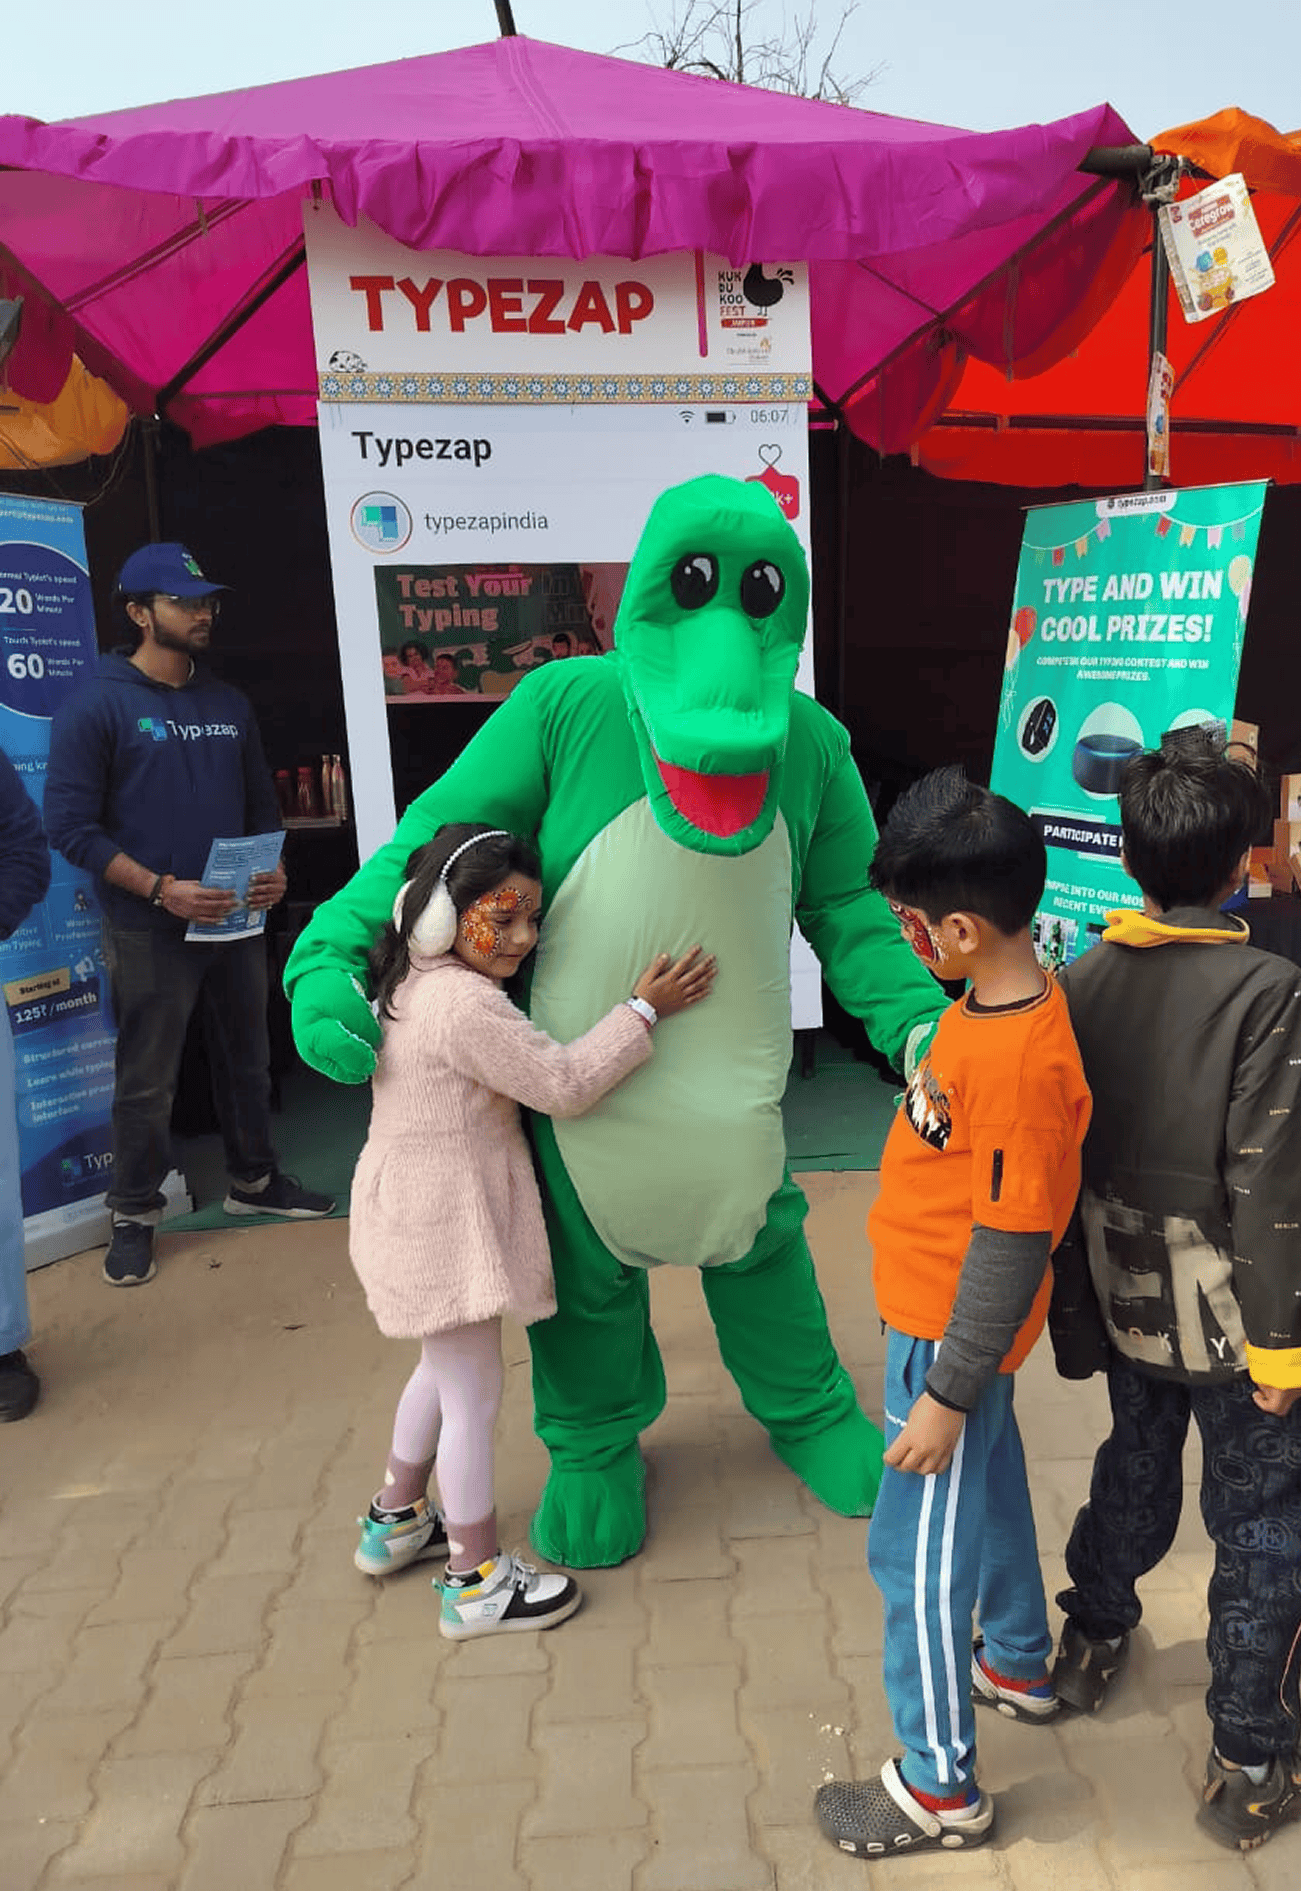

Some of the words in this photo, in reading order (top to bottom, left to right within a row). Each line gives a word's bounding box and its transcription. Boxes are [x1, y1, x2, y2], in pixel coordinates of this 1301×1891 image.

[718, 271, 741, 282] KUK
[718, 283, 733, 293] DU
[349, 275, 655, 335] TYPEZAP
[719, 294, 743, 304] KOO
[719, 305, 745, 316] FEST
[750, 409, 788, 423] 06:07
[351, 431, 492, 468] Typezap
[423, 511, 549, 535] typezapindia
[397, 573, 459, 598] Test
[463, 573, 533, 597] Your
[1043, 575, 1099, 603] TYPE
[1101, 571, 1154, 602] AND
[1159, 569, 1225, 600] WIN
[0, 587, 34, 615] 20
[399, 603, 499, 632] Typing
[1040, 614, 1102, 643] COOL
[1105, 613, 1214, 643] PRIZES!
[7, 653, 45, 679] 60
[1043, 824, 1118, 848] PARTICIPATE
[1053, 896, 1088, 913] RECENT
[1070, 884, 1096, 899] INTO
[1096, 889, 1120, 903] OUR
